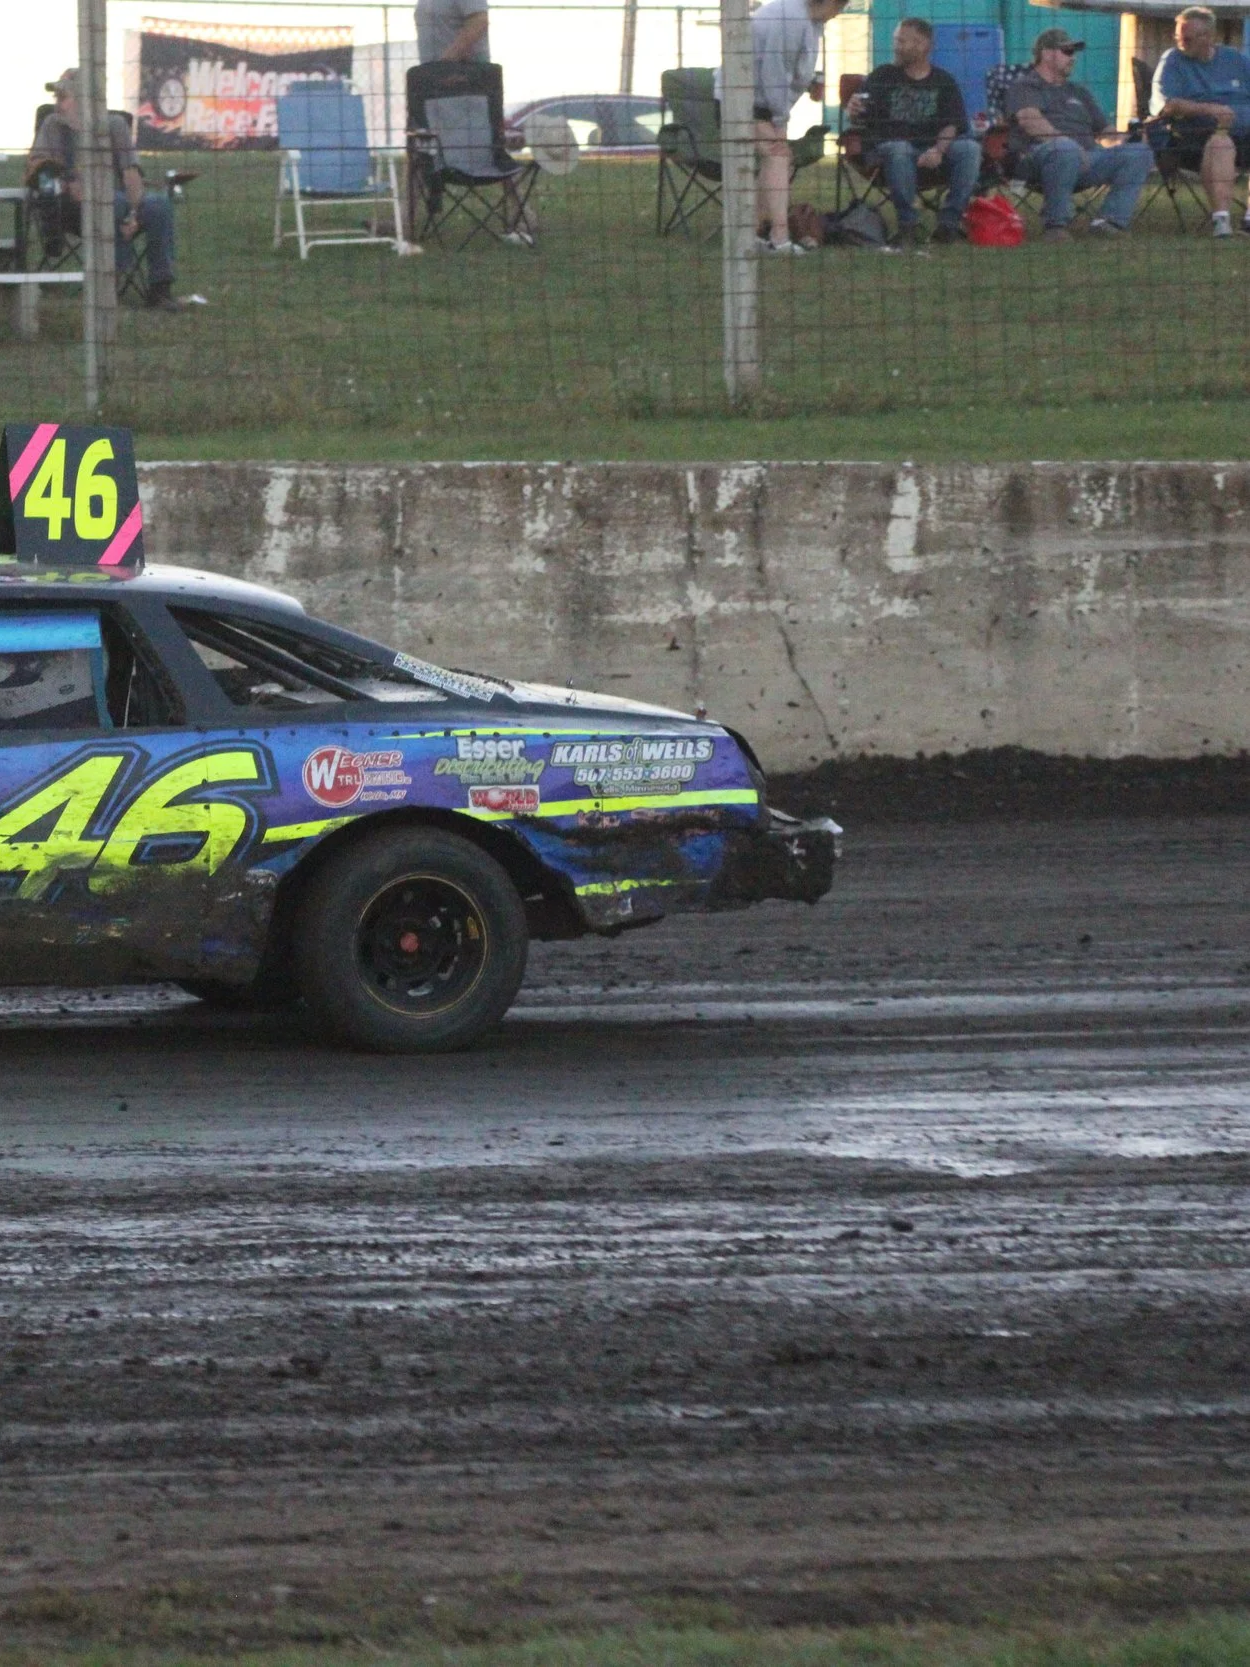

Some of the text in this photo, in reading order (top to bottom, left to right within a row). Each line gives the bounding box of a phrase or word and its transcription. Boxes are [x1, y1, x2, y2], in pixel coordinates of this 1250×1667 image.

[187, 58, 326, 99] Welcom
[24, 438, 118, 540] 46
[457, 738, 526, 760] Esser
[552, 739, 712, 764] KARLS of WELLS
